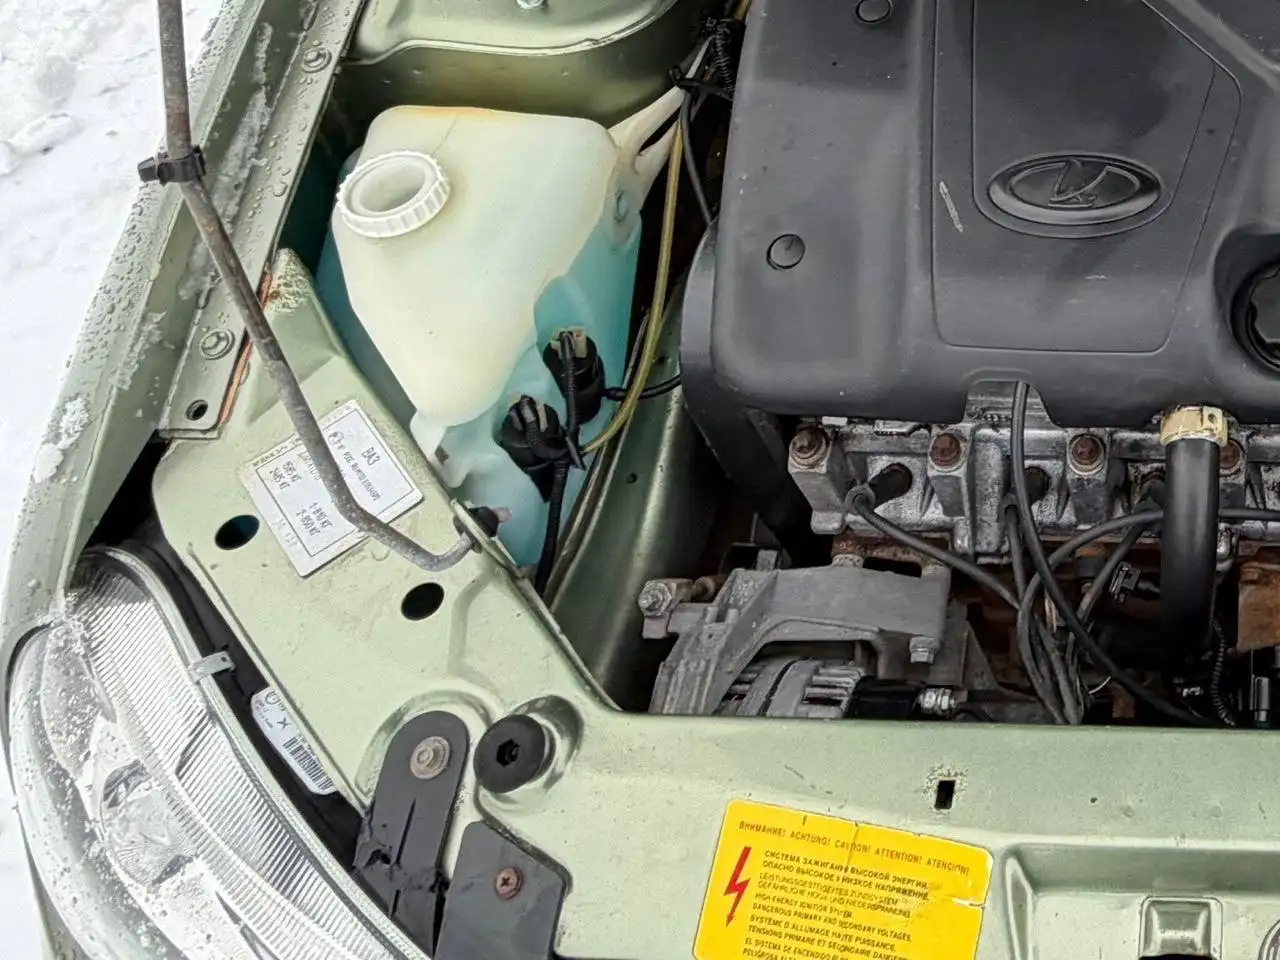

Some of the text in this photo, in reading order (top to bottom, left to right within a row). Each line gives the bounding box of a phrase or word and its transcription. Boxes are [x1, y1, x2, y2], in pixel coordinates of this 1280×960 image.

[360, 446, 381, 466] ВАЗ
[739, 820, 786, 837] ВНИМАНИЕ!
[789, 830, 830, 846] ACHTUNG!
[874, 847, 922, 864] ATTENTION!
[761, 859, 794, 873] ОПАСНО
[794, 866, 835, 882] ВЫСОКОЕ
[840, 875, 873, 889] НИЗКОЕ
[764, 850, 800, 863] СИСТЕМА
[849, 866, 890, 881] ВЫСОКОЙ
[752, 902, 792, 916] DANGEROUS
